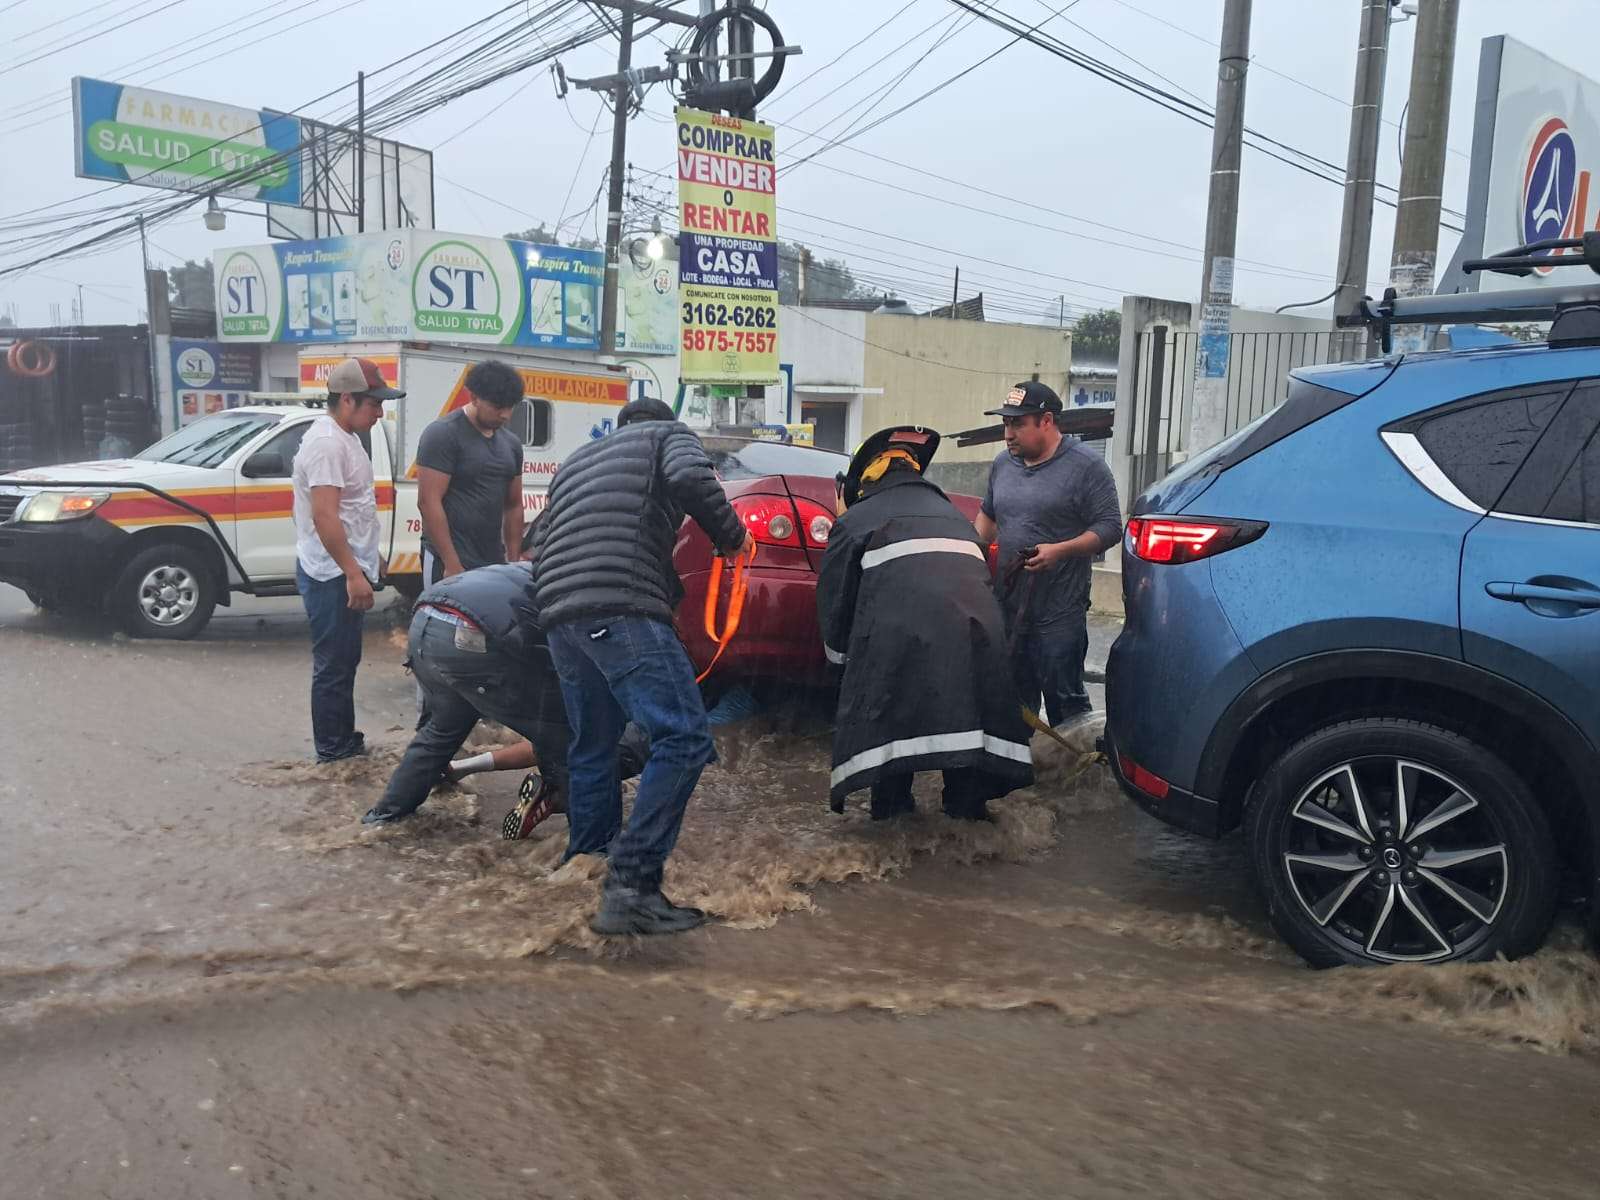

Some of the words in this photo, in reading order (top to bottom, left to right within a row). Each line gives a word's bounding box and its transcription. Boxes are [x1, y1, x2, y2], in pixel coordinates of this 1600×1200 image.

[98, 129, 190, 163] SALUD
[679, 123, 773, 161] COMPRAR
[679, 151, 773, 192] VENDER
[724, 190, 733, 206] O
[683, 202, 770, 237] RENTAR
[694, 236, 713, 247] UNA
[716, 239, 764, 252] PROPIEDAD
[697, 248, 761, 276] CASA
[429, 265, 485, 310] ST
[682, 272, 698, 283] LOTE
[702, 274, 729, 285] BODEGA
[733, 277, 752, 287] LOCAL
[757, 279, 774, 288] FINCA
[227, 275, 257, 314] ST
[686, 289, 725, 300] COMUNICATE
[727, 292, 739, 301] CON
[741, 294, 772, 302] NOSOTROS
[224, 320, 245, 332] SALUD
[418, 314, 460, 328] SALUD
[465, 317, 500, 330] TOTAL
[682, 302, 776, 328] 3162-6262
[683, 328, 777, 353] 5875-7557
[186, 359, 206, 372] ST
[523, 376, 610, 400] MBULANCIA
[523, 461, 560, 474] ENANG
